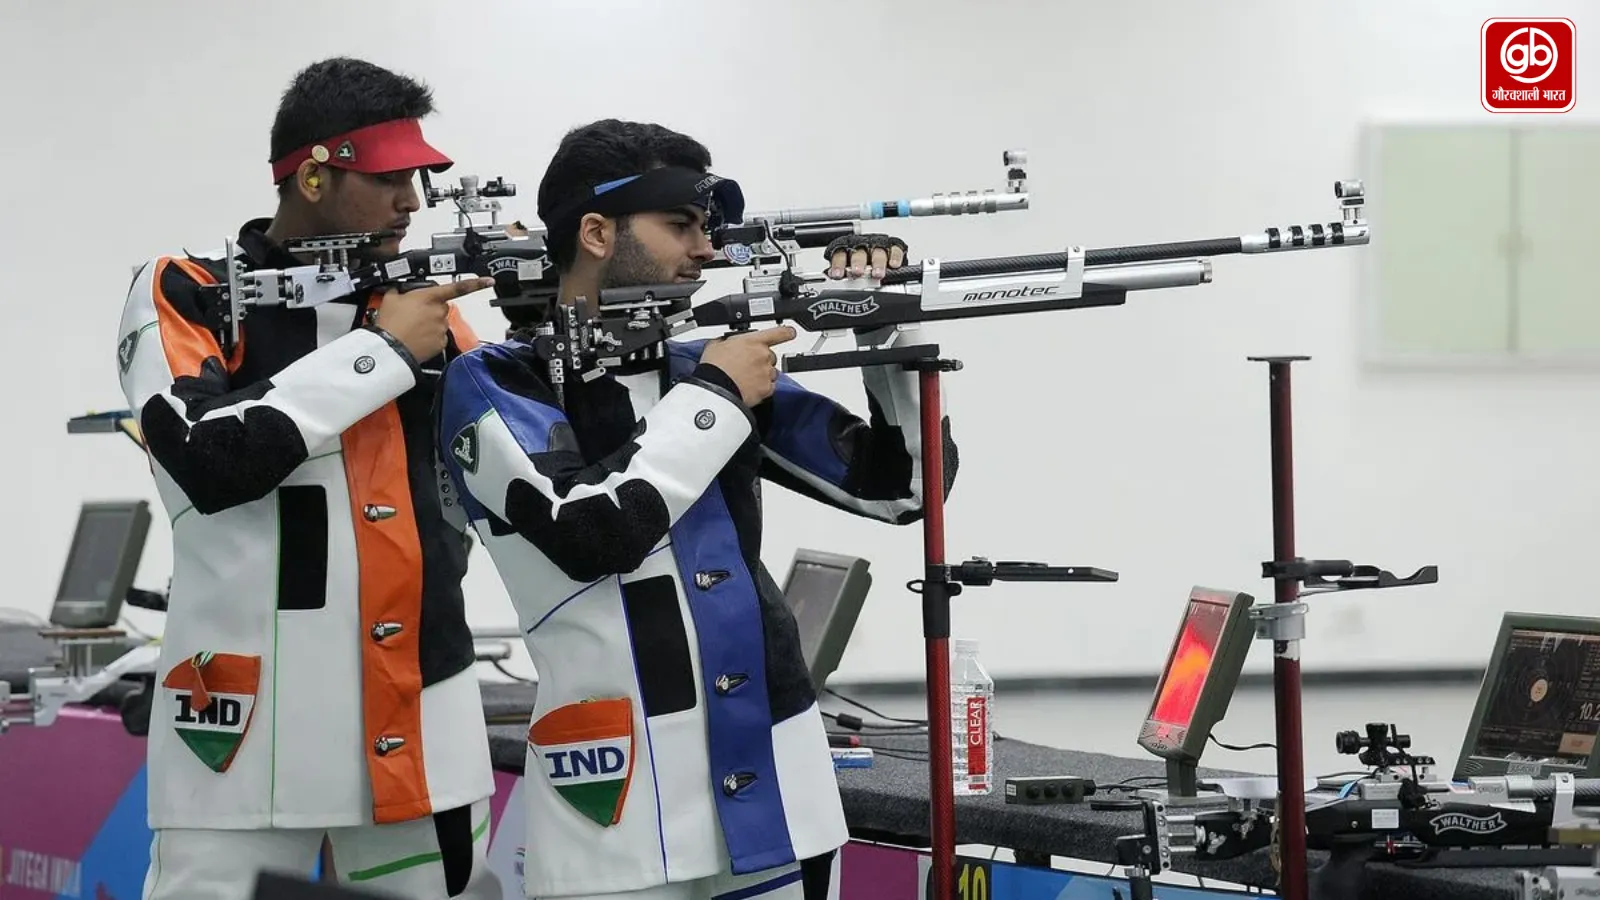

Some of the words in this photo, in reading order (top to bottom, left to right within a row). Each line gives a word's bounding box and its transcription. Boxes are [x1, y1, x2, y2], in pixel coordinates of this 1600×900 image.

[817, 302, 870, 314] WALTHER
[962, 285, 1060, 301] monotec
[175, 694, 241, 727] IND
[970, 701, 981, 745] CLEAR
[544, 746, 625, 778] IND
[1440, 816, 1497, 830] WALTHER
[958, 863, 987, 900] 10
